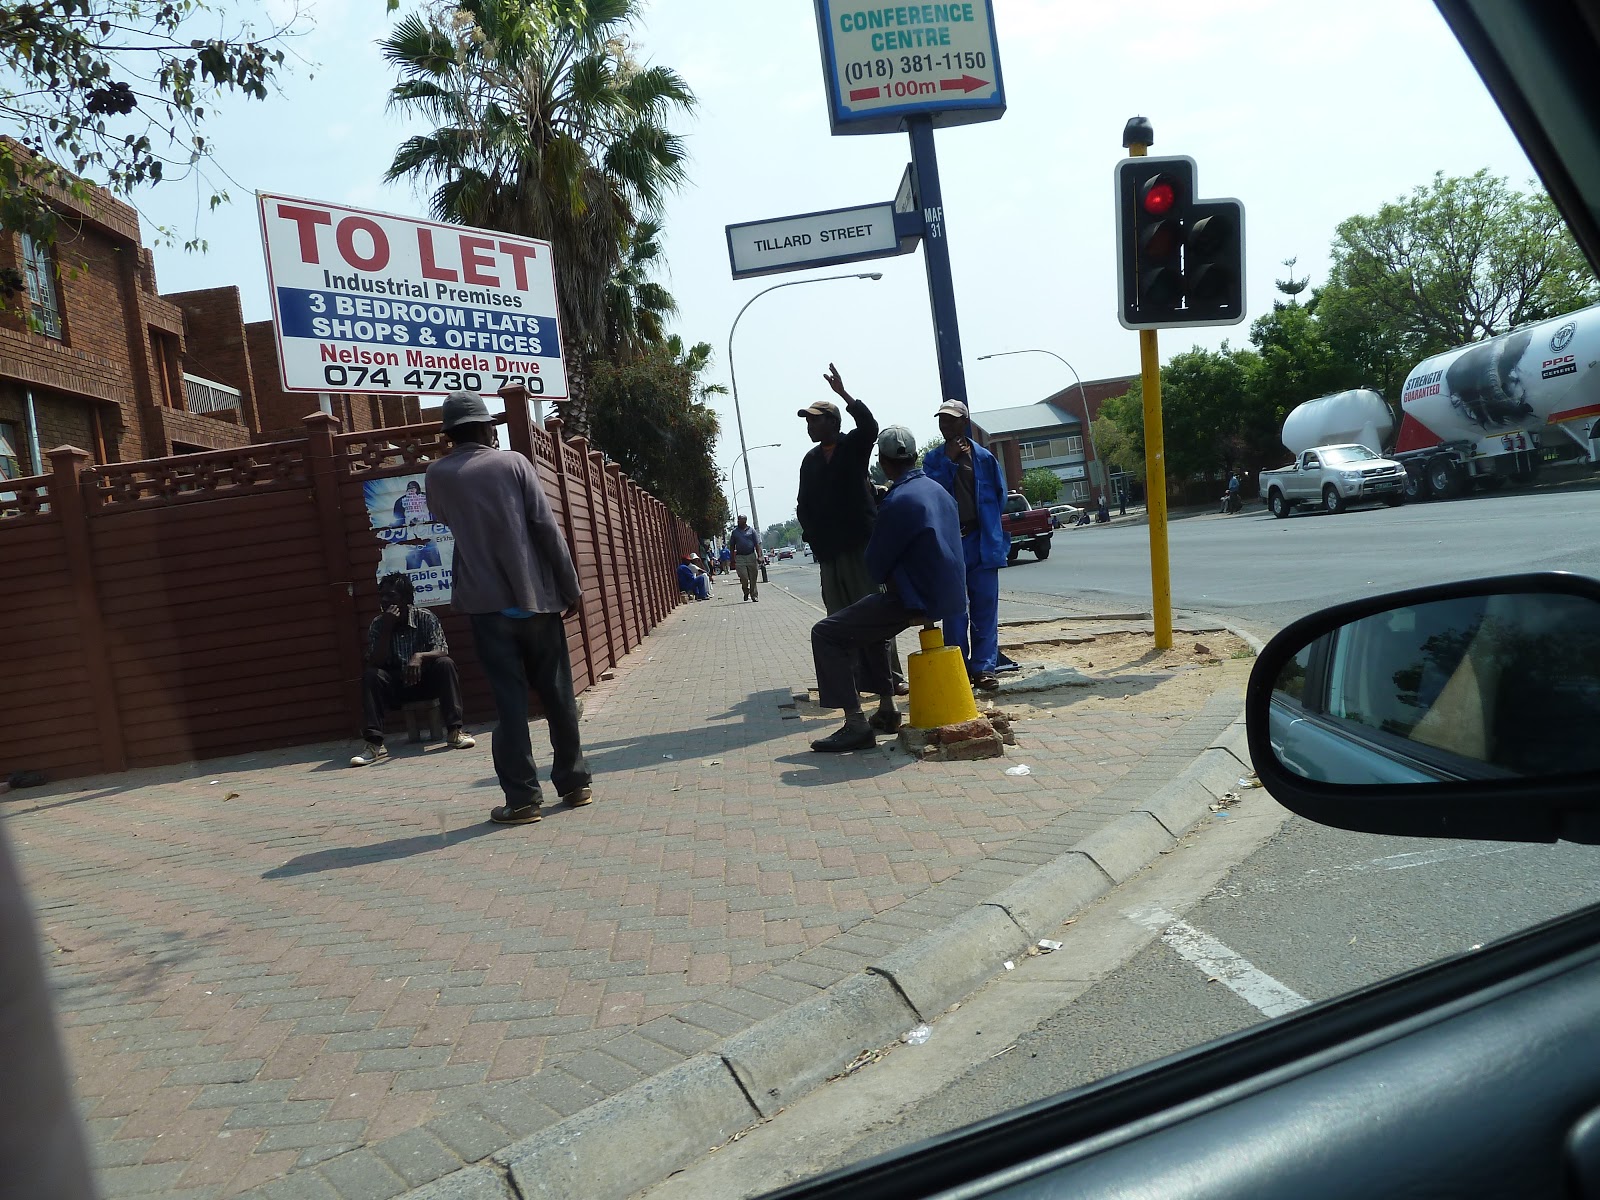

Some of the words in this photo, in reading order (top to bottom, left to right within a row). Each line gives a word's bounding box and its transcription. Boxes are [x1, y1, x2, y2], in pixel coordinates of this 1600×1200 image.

[840, 4, 974, 33] CONFERENCE
[871, 27, 951, 52] CENTRE
[845, 58, 894, 85] (018)
[900, 51, 986, 73] 381-1150
[883, 80, 936, 98] 100m
[924, 206, 943, 223] MAF
[754, 234, 812, 252] TILLARD
[820, 224, 873, 243] STREET
[931, 223, 942, 238] 31
[277, 204, 390, 272] TO
[416, 227, 536, 291] LET
[323, 269, 429, 299] Industrial
[436, 283, 523, 308] Premises
[308, 293, 326, 313] 3
[336, 296, 465, 327] BEDROOM
[473, 312, 540, 335] FLATS
[312, 318, 410, 343] SHOPS
[419, 326, 437, 345] &
[445, 329, 542, 354] OFFICES
[319, 343, 399, 366] Nelson
[405, 350, 489, 372] Mandela
[496, 356, 540, 374] Drive
[1542, 355, 1575, 368] PPC
[1543, 366, 1575, 377] CEMENT
[324, 364, 391, 388] 074
[403, 369, 482, 392] 4730
[1406, 369, 1443, 390] STRENGTH
[1404, 383, 1440, 403] GUARANTEED
